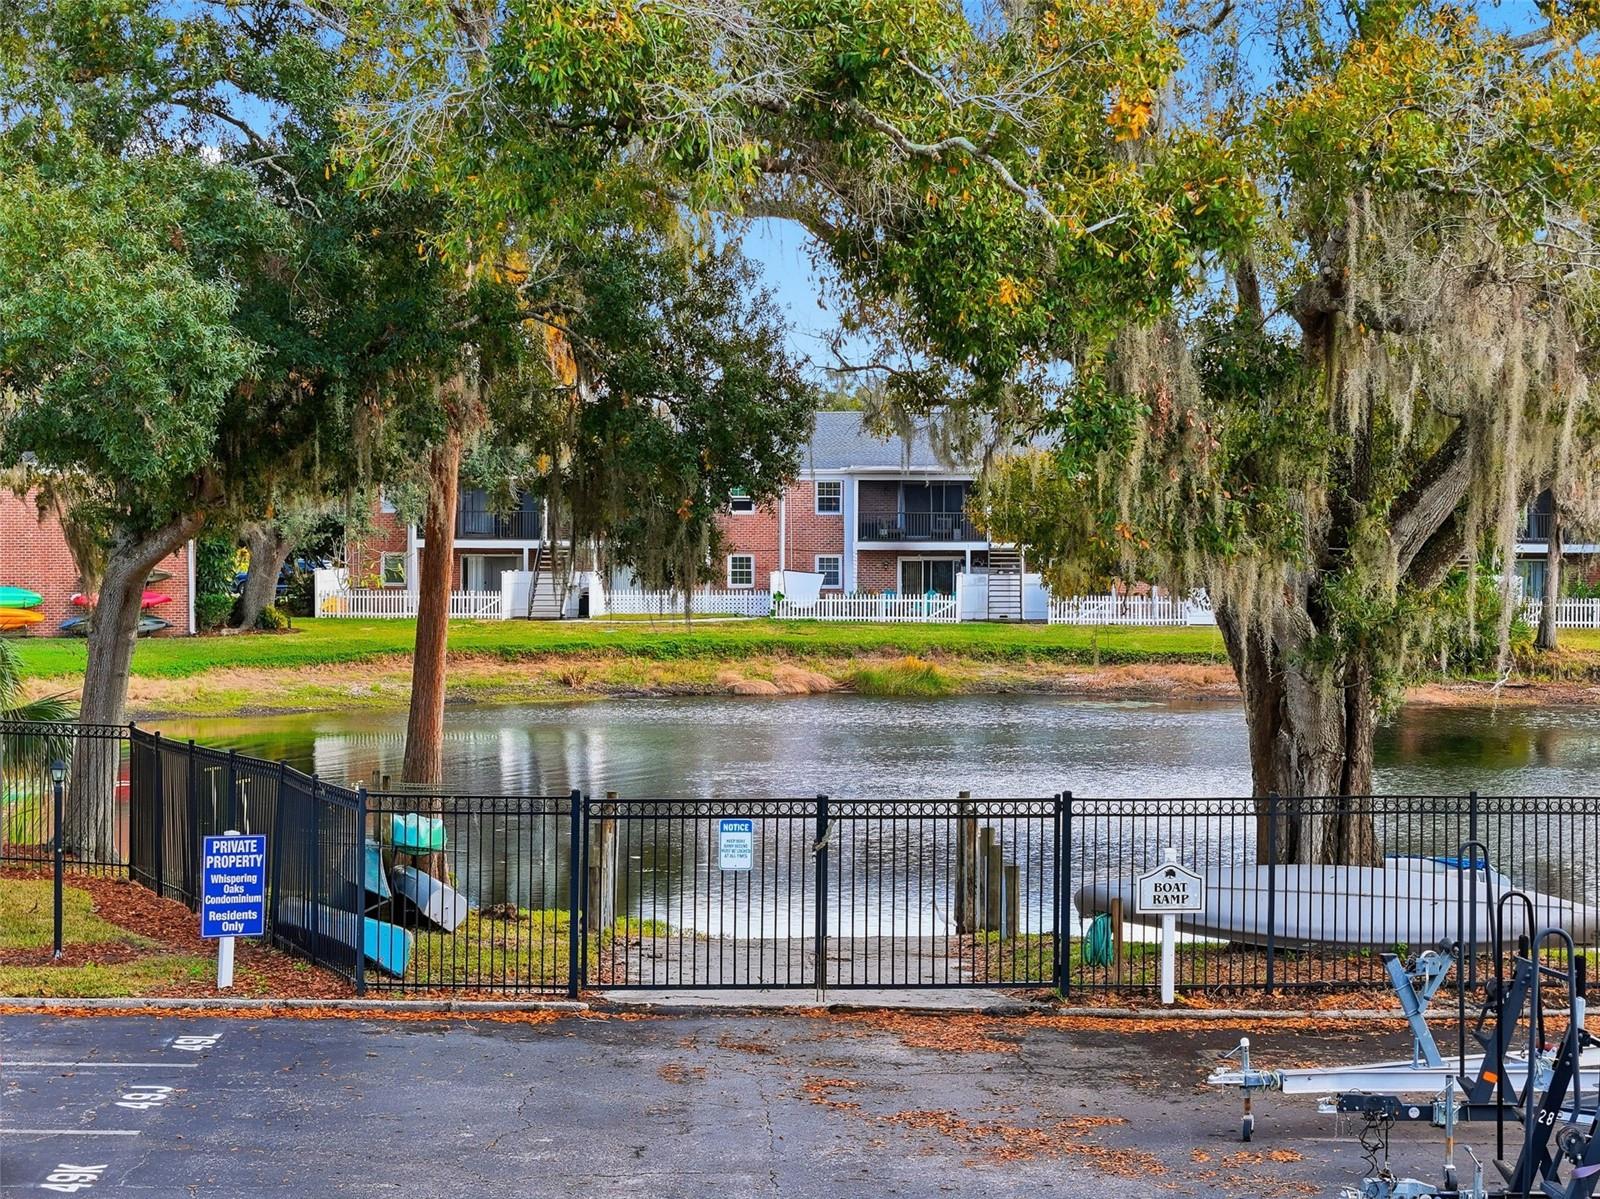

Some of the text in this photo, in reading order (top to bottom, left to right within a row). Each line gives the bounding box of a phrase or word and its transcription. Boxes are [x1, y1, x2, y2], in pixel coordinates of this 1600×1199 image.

[723, 823, 750, 831] NOTICE
[213, 840, 257, 853] PRIVATE
[206, 854, 263, 869] PROPERTY
[210, 873, 257, 884] Whispering
[223, 884, 245, 893] Oaks
[1154, 883, 1188, 892] BOAT
[205, 894, 261, 904] Condominium
[1152, 895, 1189, 904] RAMP
[209, 910, 257, 921] Residents
[222, 921, 244, 933] Only
[172, 1032, 224, 1050] 49L
[115, 1085, 173, 1109] 49J
[1538, 1109, 1555, 1126] 28
[40, 1163, 109, 1193] 49K
